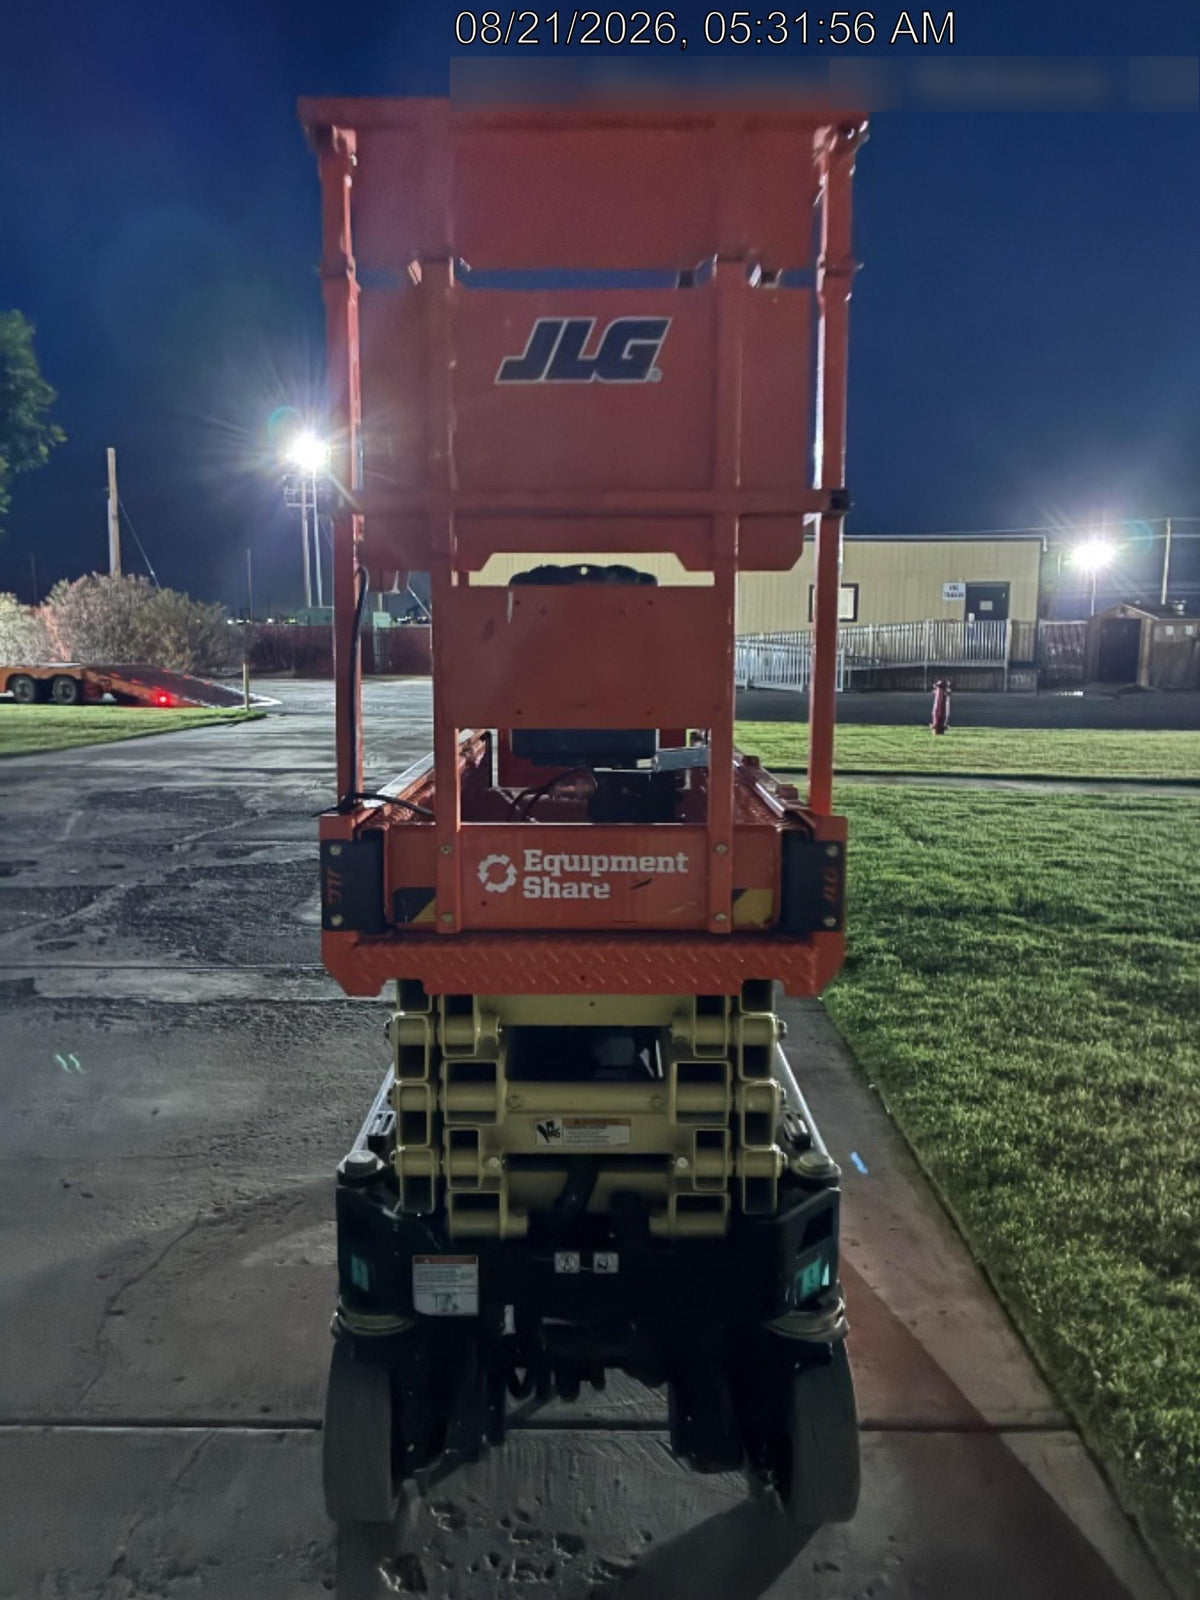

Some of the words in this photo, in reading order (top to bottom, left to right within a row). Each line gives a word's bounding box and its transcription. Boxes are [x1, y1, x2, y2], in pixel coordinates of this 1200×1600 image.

[494, 316, 673, 384] JLG
[523, 849, 689, 877] Equipment
[523, 876, 610, 899] Share
